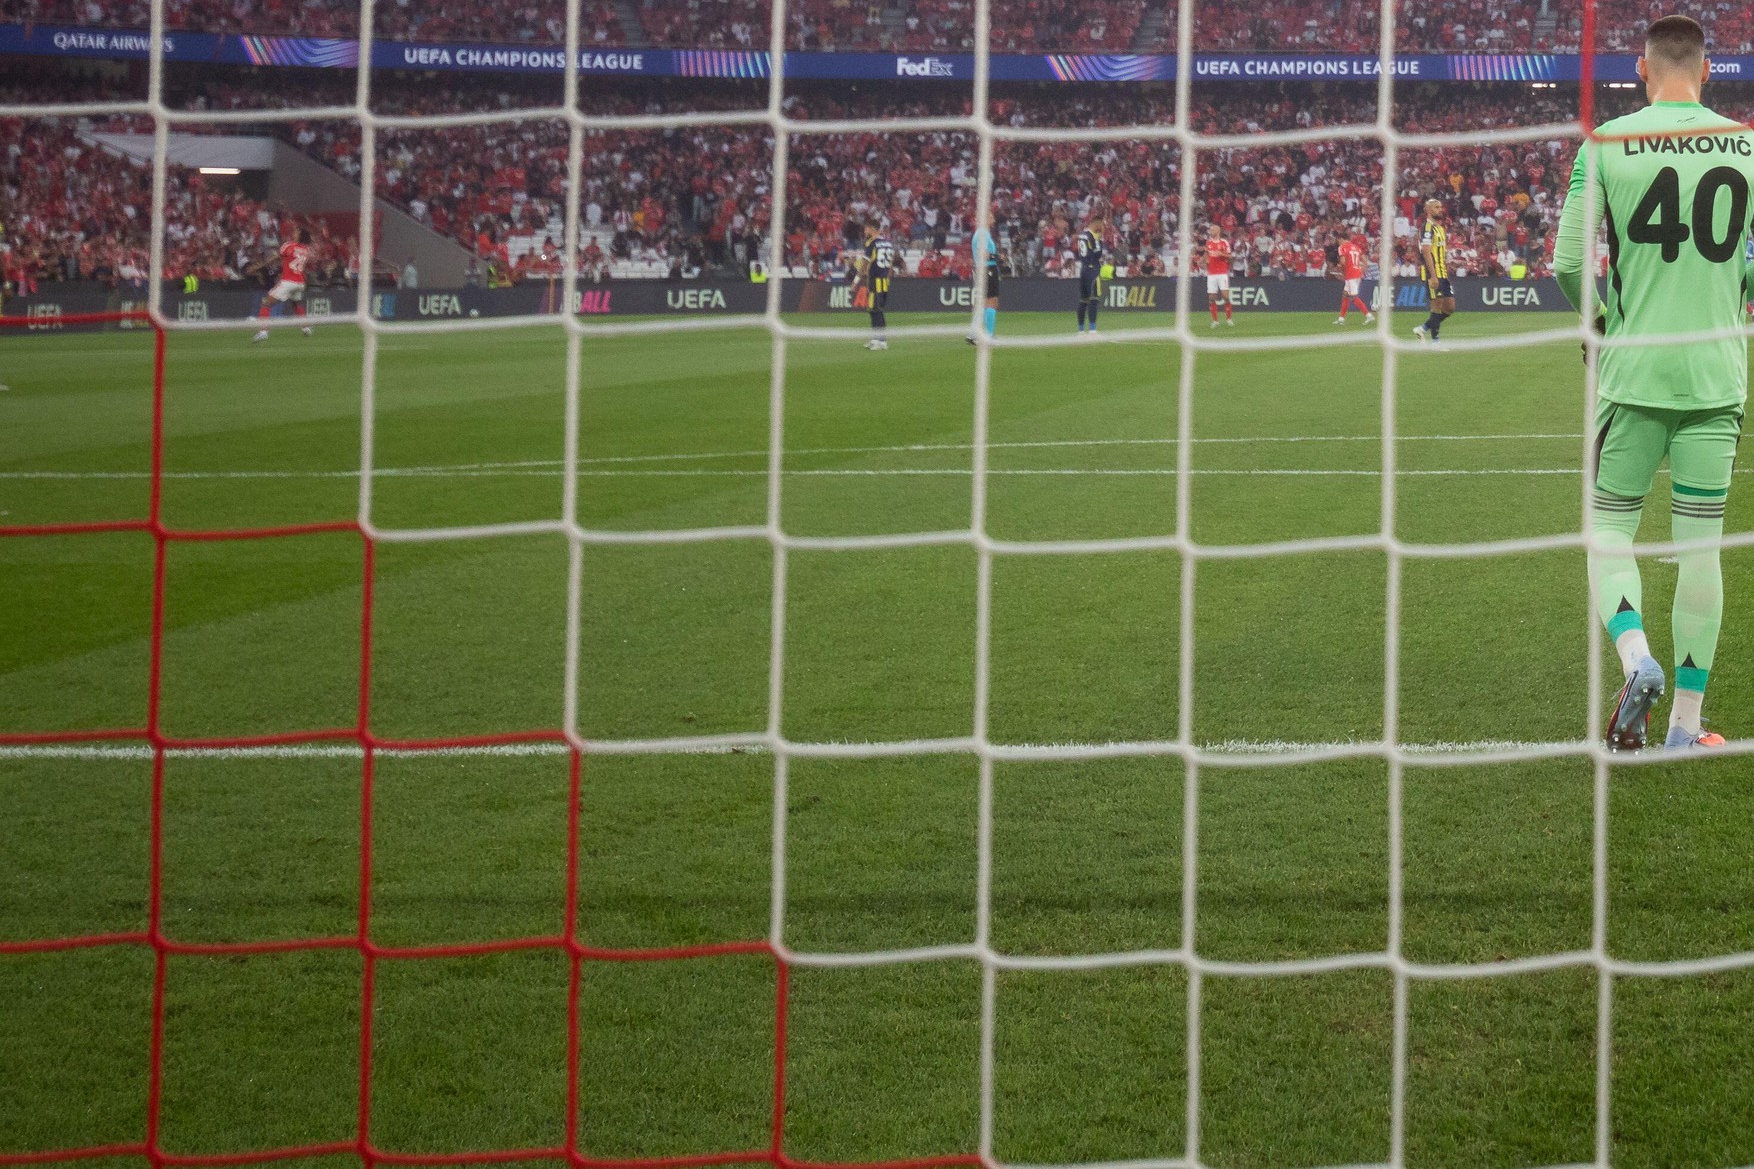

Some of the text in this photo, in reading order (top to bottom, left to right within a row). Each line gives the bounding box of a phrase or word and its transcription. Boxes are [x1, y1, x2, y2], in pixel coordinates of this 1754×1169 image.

[54, 32, 175, 53] QATAR AIRWS
[404, 48, 644, 70] UEFA CHAMPIONS LEAGUE
[896, 57, 954, 77] FedEx
[1196, 60, 1420, 76] UEFA CHAMPIONS LEAGUE
[1627, 166, 1749, 263] 40
[1348, 250, 1360, 266] 17
[418, 295, 462, 316] UEFA
[666, 289, 727, 309] UEFA
[1482, 287, 1540, 306] UEFA
